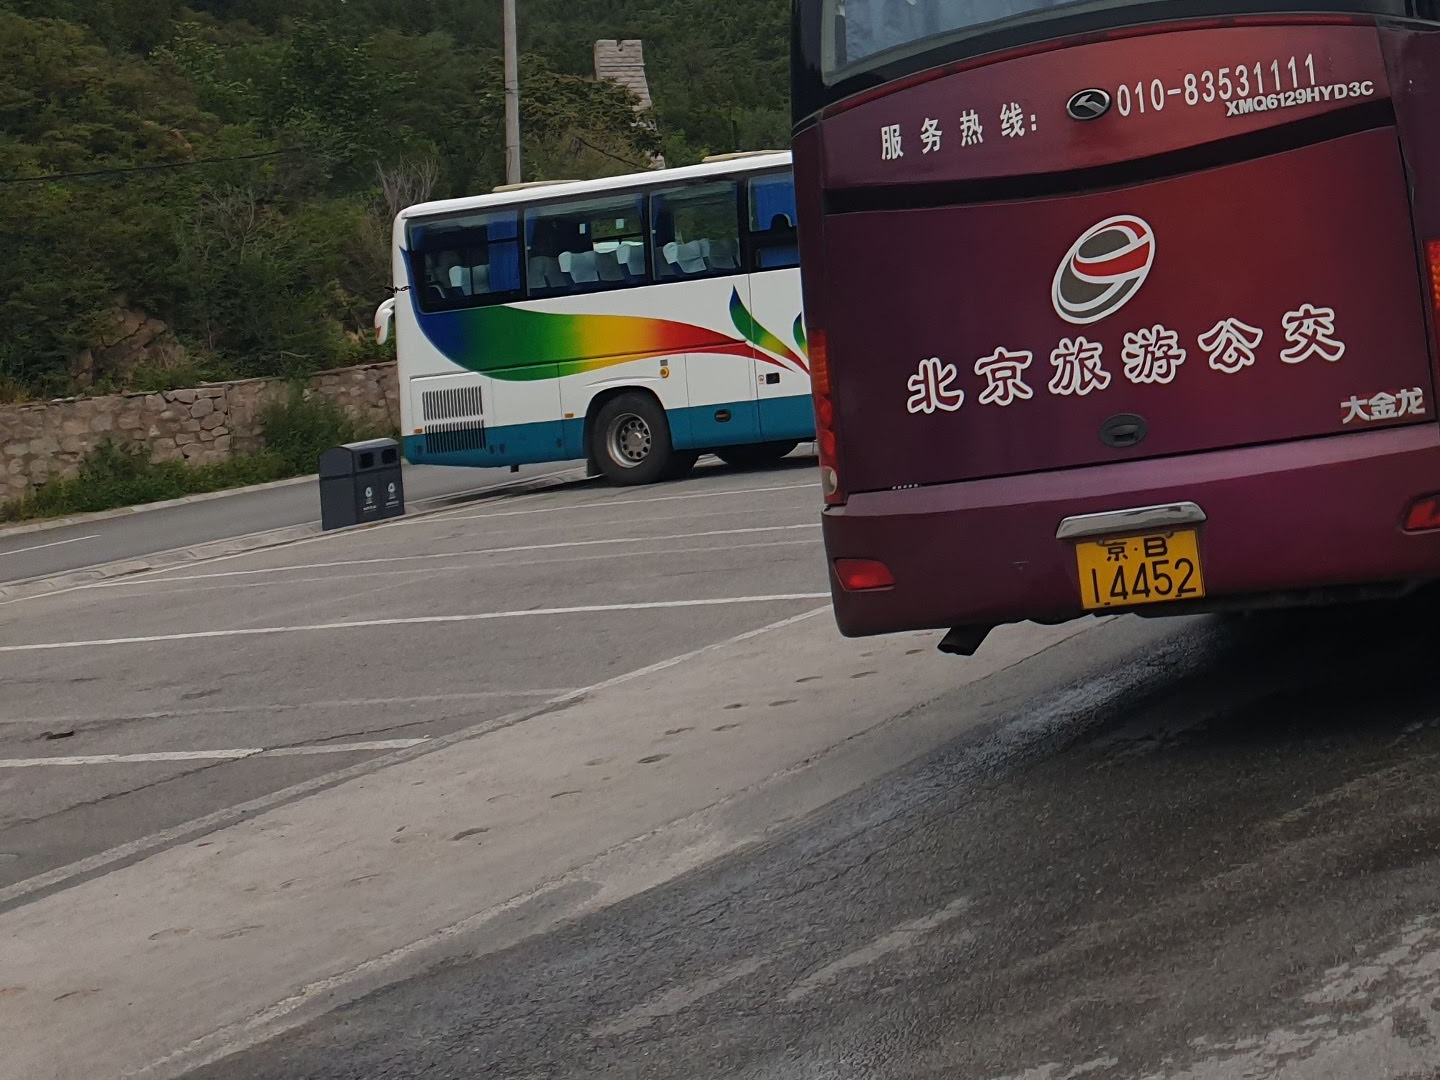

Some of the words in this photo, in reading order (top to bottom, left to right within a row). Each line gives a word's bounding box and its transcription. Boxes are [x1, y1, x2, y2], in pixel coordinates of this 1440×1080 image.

[1116, 53, 1316, 117] 010-83531111
[1225, 80, 1374, 117] XMQ6129HYD3C
[907, 304, 1346, 415] 北京旅游公交
[1340, 387, 1426, 425] 大金龙
[1091, 557, 1197, 604] 14452
